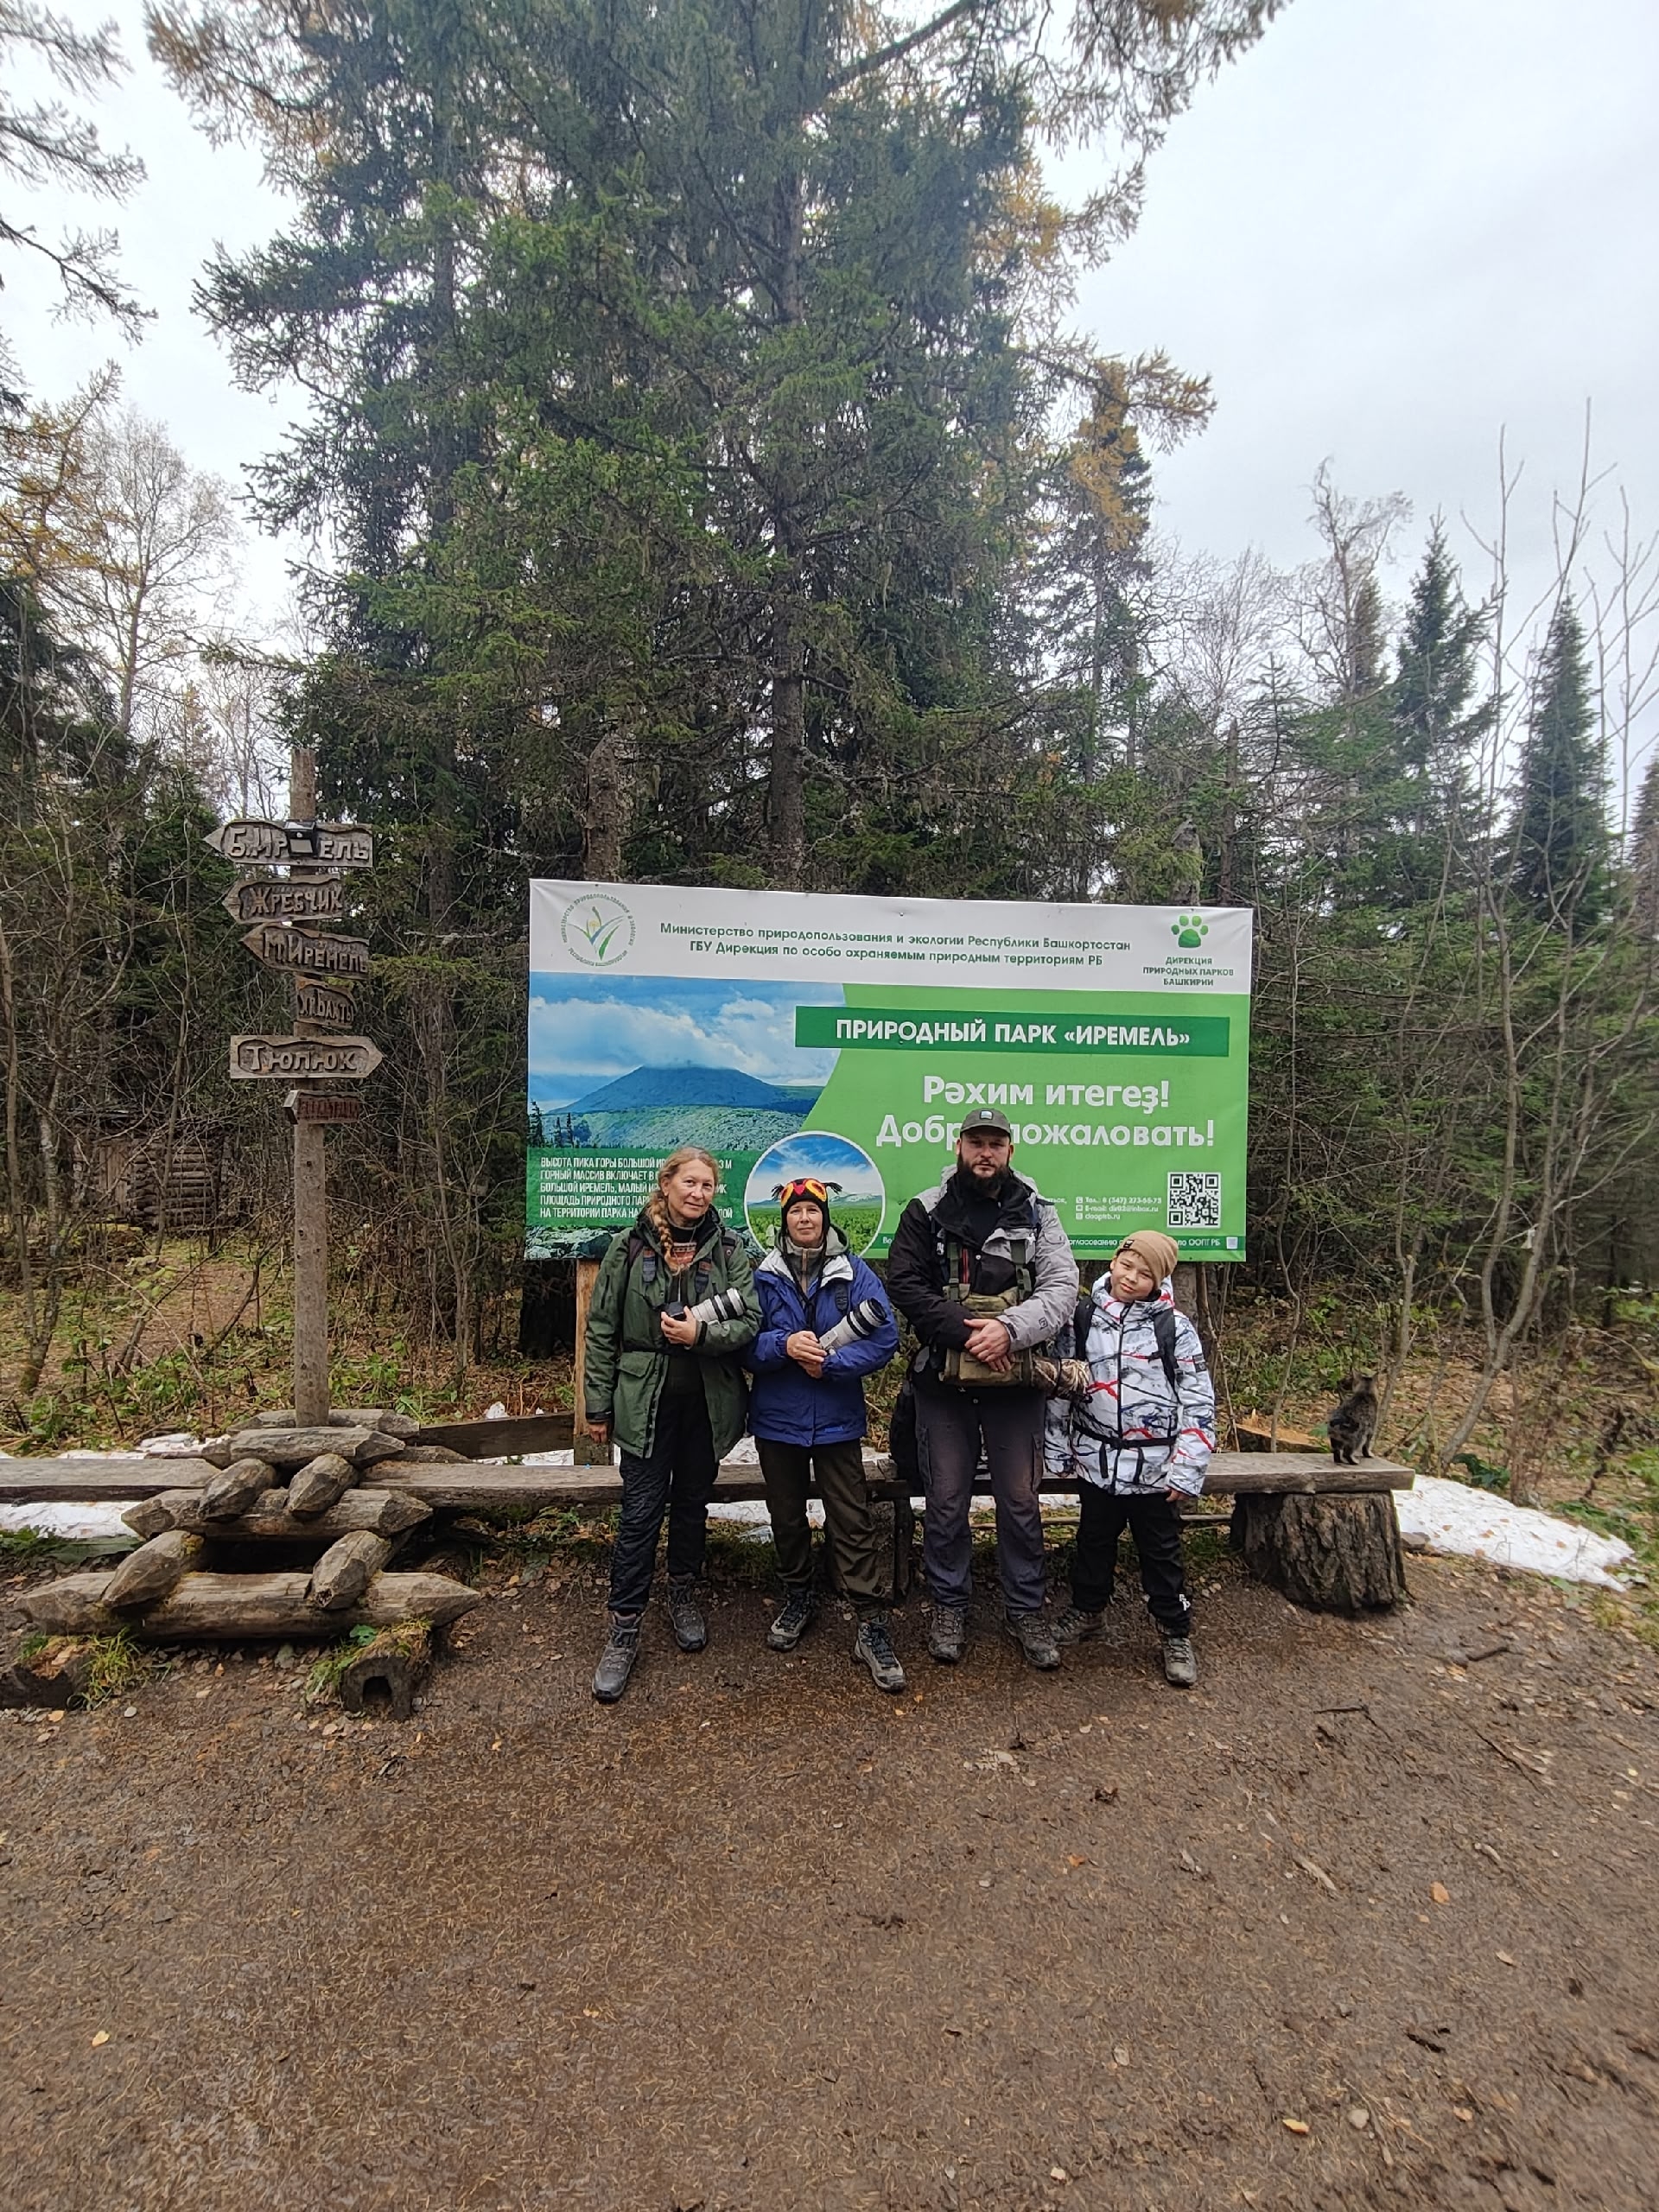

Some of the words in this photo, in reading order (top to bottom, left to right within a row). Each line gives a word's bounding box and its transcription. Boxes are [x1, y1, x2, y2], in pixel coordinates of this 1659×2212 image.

[230, 827, 369, 860] Б.ИРЕЛЬ
[661, 923, 754, 938] Министерство
[759, 928, 893, 943] природопользования
[908, 936, 964, 946] экологии
[968, 936, 1039, 949] Республики
[1043, 938, 1130, 950] Башкортостан
[690, 940, 712, 951] ГБУ
[715, 942, 779, 956] Дирекция
[782, 946, 798, 955] по
[803, 946, 842, 957] особо
[846, 948, 925, 961] охраняемым
[930, 952, 1001, 963] природным
[1004, 955, 1084, 966] территориям
[1088, 956, 1103, 965] РБ
[1166, 957, 1212, 966] ДИРЕКЦИЯ
[1143, 967, 1198, 976] ПРИРОДНЫХ
[1163, 978, 1214, 987] БАШКИРИИ
[836, 1018, 987, 1045] ПРИРОДНЫЙ
[995, 1023, 1058, 1044] ПАРК
[1064, 1025, 1190, 1046] «ИРЕМЕЛЬ»
[923, 1075, 1034, 1106] Рәхим
[1046, 1079, 1170, 1115] итегеҙ!
[876, 1114, 963, 1151] Добр
[541, 1157, 572, 1167] ВЫСОТА
[574, 1158, 594, 1167] ПИКА
[595, 1158, 617, 1168] ГОРЫ
[618, 1157, 655, 1168] БОЛЬШОЙ
[540, 1169, 571, 1180] ГОРНЫЙ
[574, 1170, 604, 1179] МАССИВ
[606, 1170, 648, 1180] ВКЛЮЧАЕТ
[649, 1171, 654, 1180] В
[540, 1181, 578, 1192] БОЛЬШОЙ
[580, 1182, 617, 1193] ИРЕМЕЛЬ,
[619, 1182, 647, 1193] МАЛЫЙ
[540, 1195, 580, 1205] ПЛОЩАДЬ
[582, 1195, 630, 1206] ПРИРОДНОГО
[632, 1195, 649, 1205] ПАР
[540, 1207, 551, 1218] НА
[553, 1207, 600, 1218] ТЕРРИТОРИИ
[601, 1208, 626, 1217] ПАРКА
